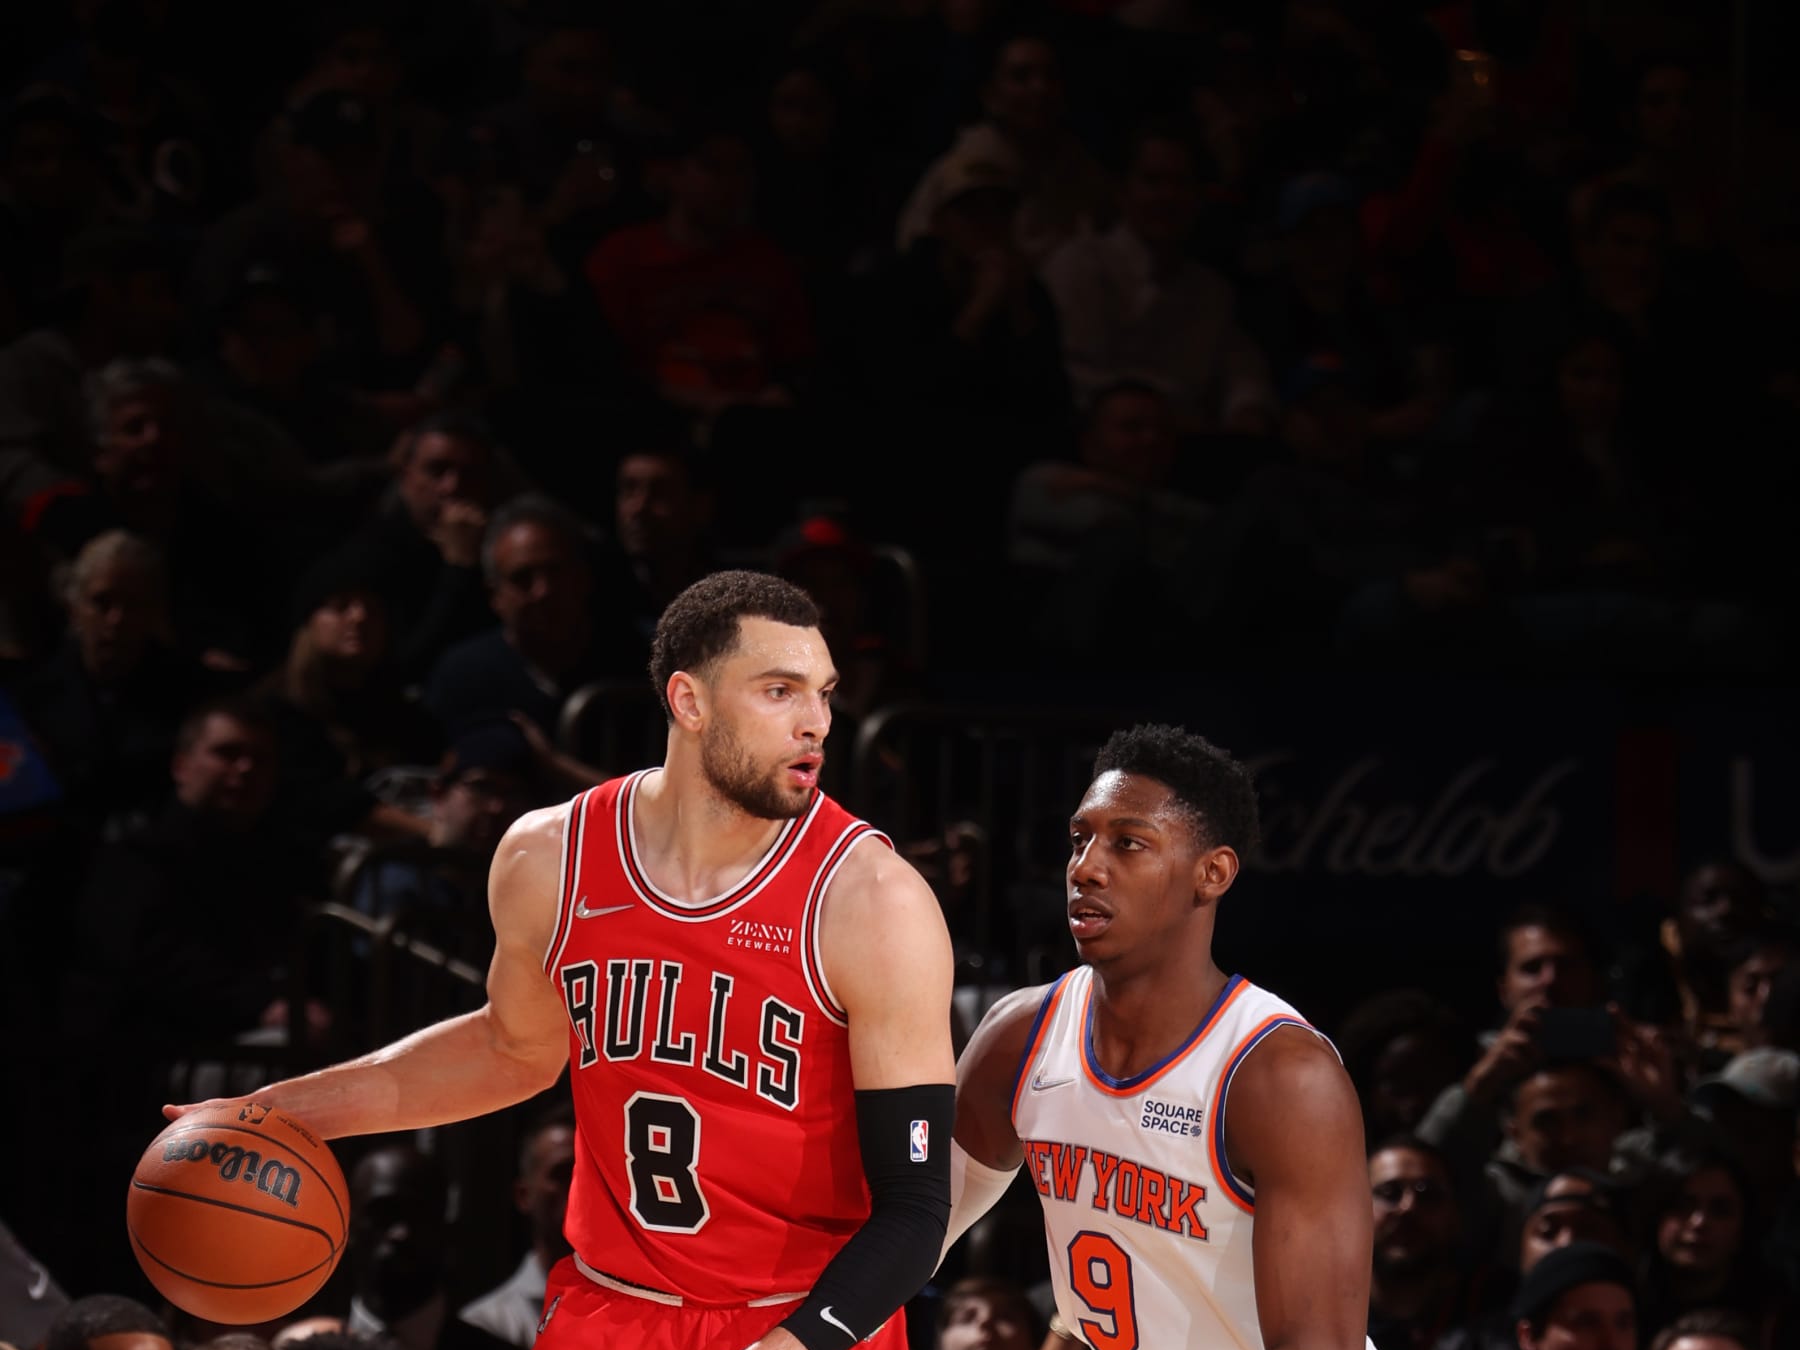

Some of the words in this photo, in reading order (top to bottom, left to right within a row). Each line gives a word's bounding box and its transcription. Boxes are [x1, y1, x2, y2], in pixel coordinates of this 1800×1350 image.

[1240, 748, 1583, 877] chelob
[727, 936, 790, 954] EYEWEAR
[729, 919, 793, 942] ZENNI
[560, 958, 805, 1111] BULLS
[1141, 1115, 1190, 1136] SPACE
[1144, 1100, 1203, 1123] SQUARE
[162, 1139, 302, 1208] Wilson
[623, 1090, 711, 1235] 8
[1089, 1149, 1209, 1242] YORK
